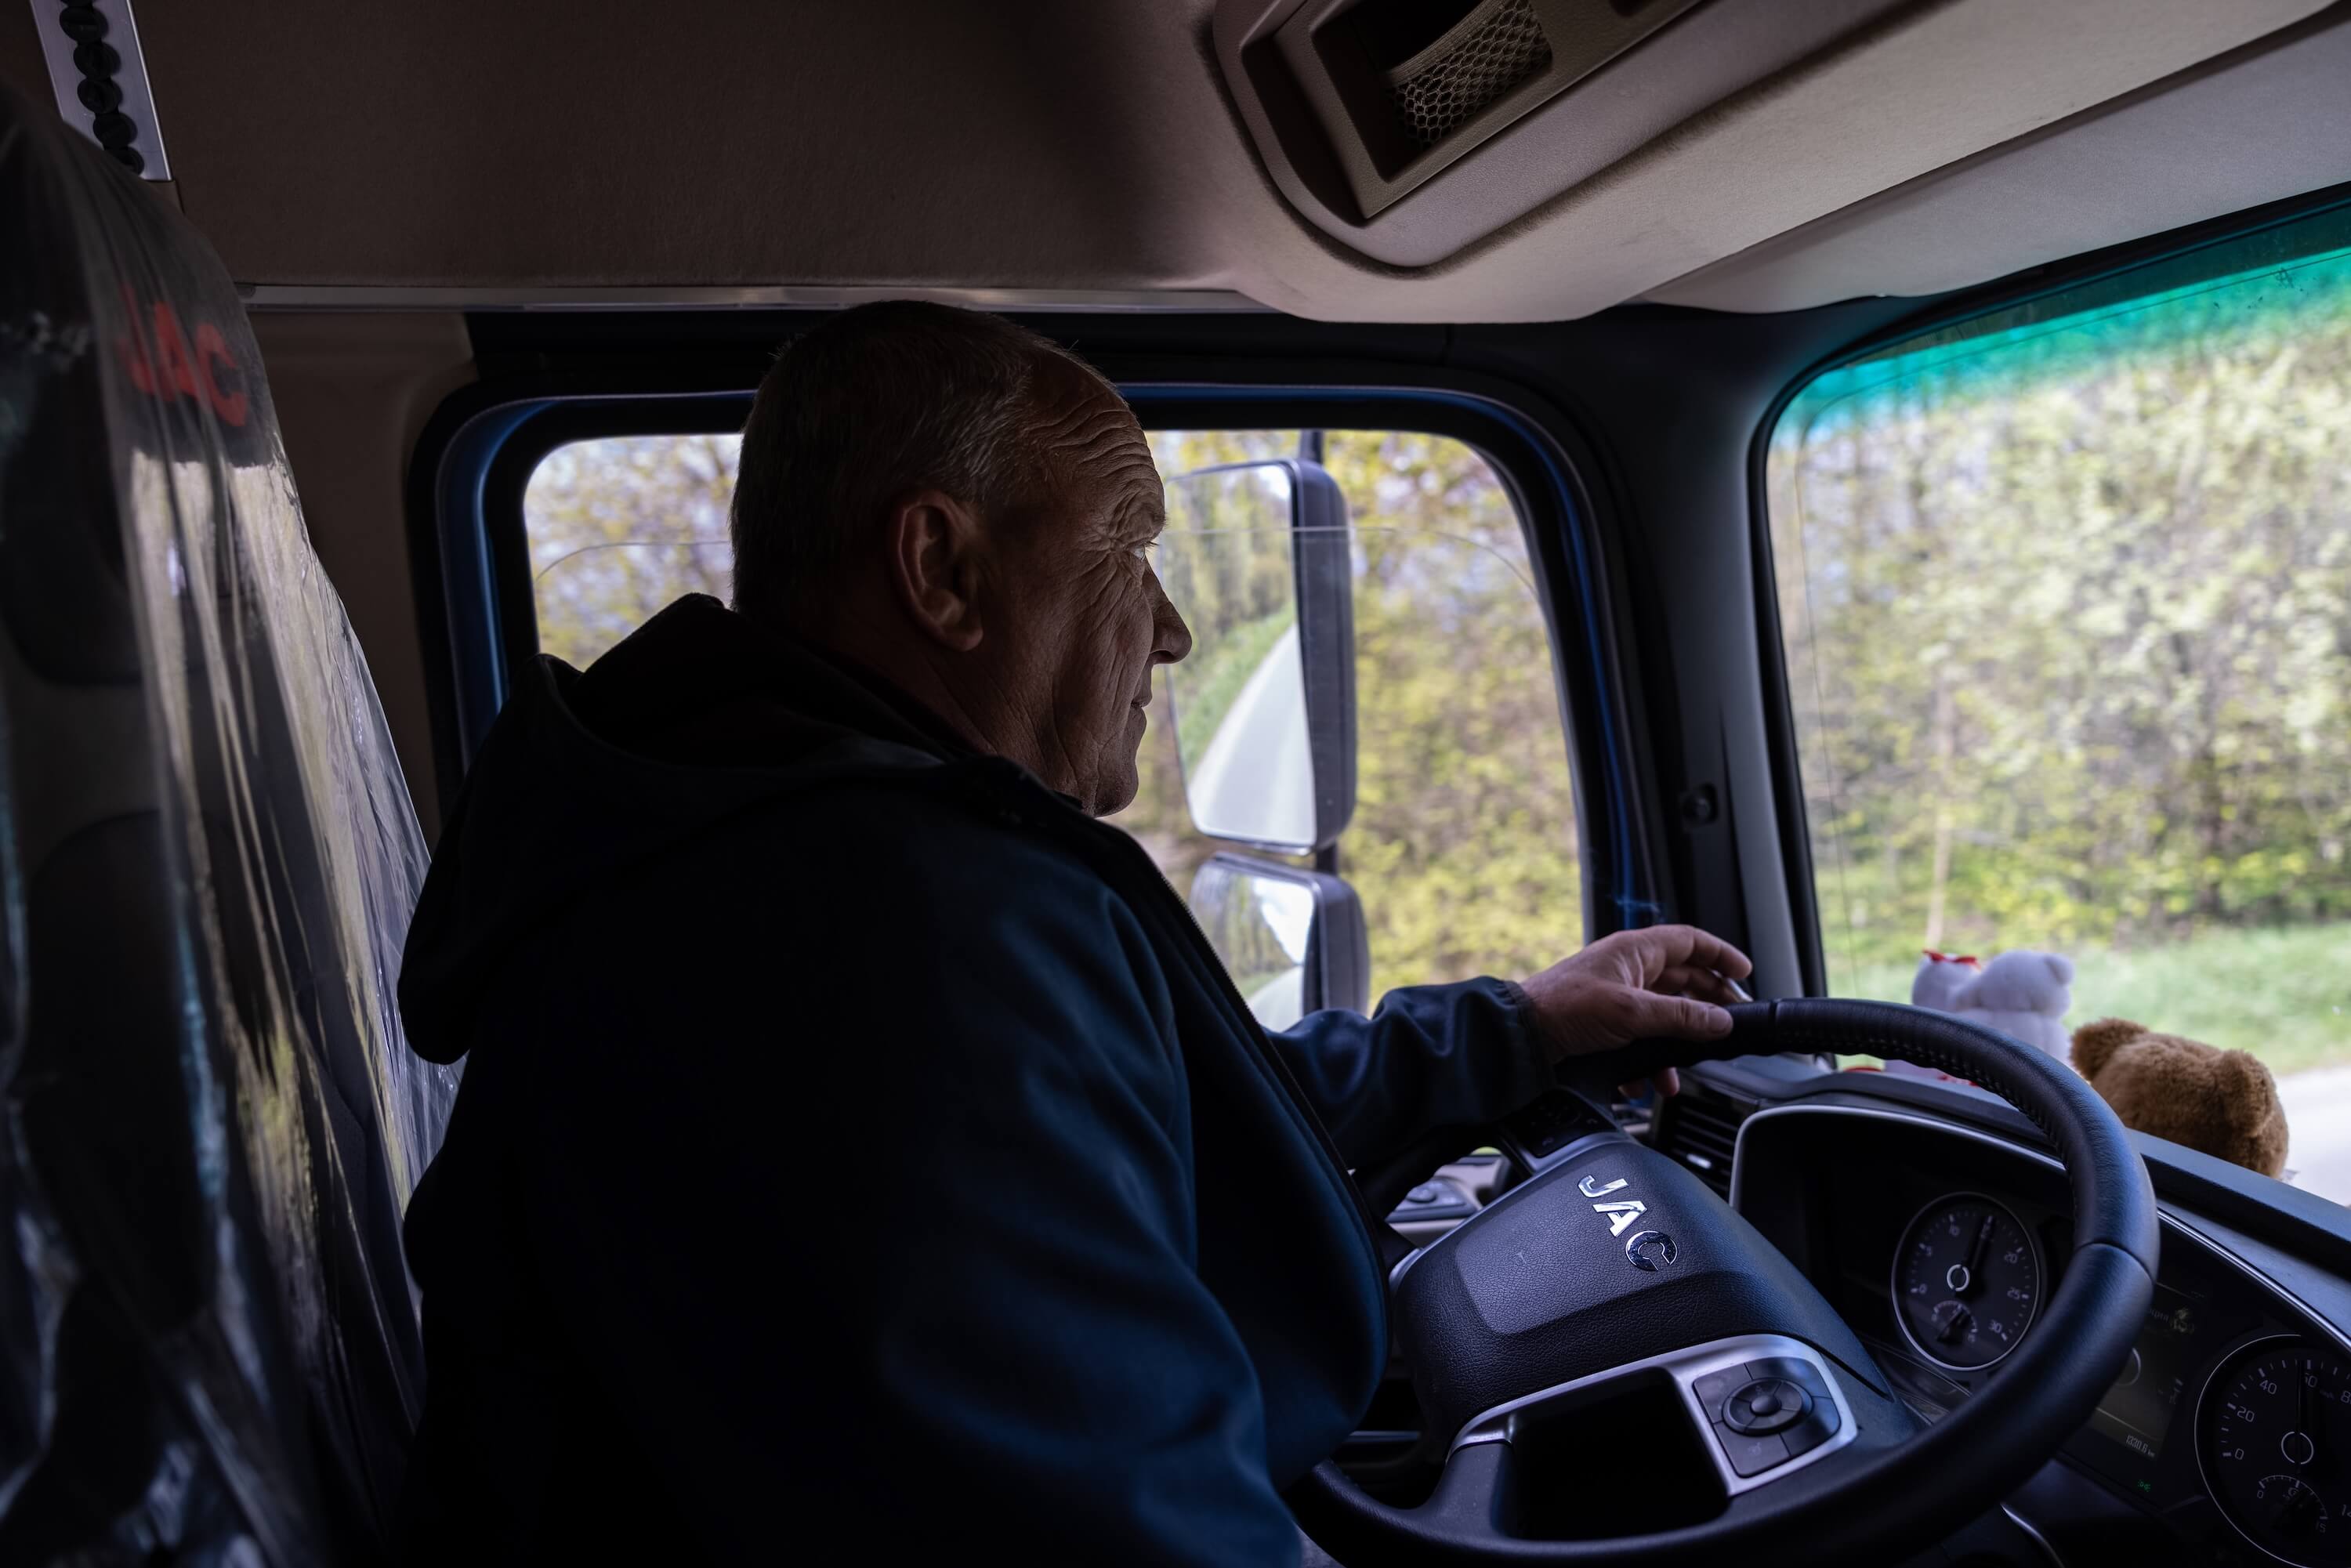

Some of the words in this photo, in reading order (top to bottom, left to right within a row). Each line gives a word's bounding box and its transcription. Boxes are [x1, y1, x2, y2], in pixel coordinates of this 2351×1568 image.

[118, 281, 248, 428] JAC
[1577, 1175, 1678, 1272] JAC
[1988, 1319, 2003, 1334] 30
[2259, 1378, 2278, 1396] 40
[2339, 1390, 2351, 1406] 8
[2236, 1407, 2255, 1422] 20
[2234, 1447, 2244, 1461] 0
